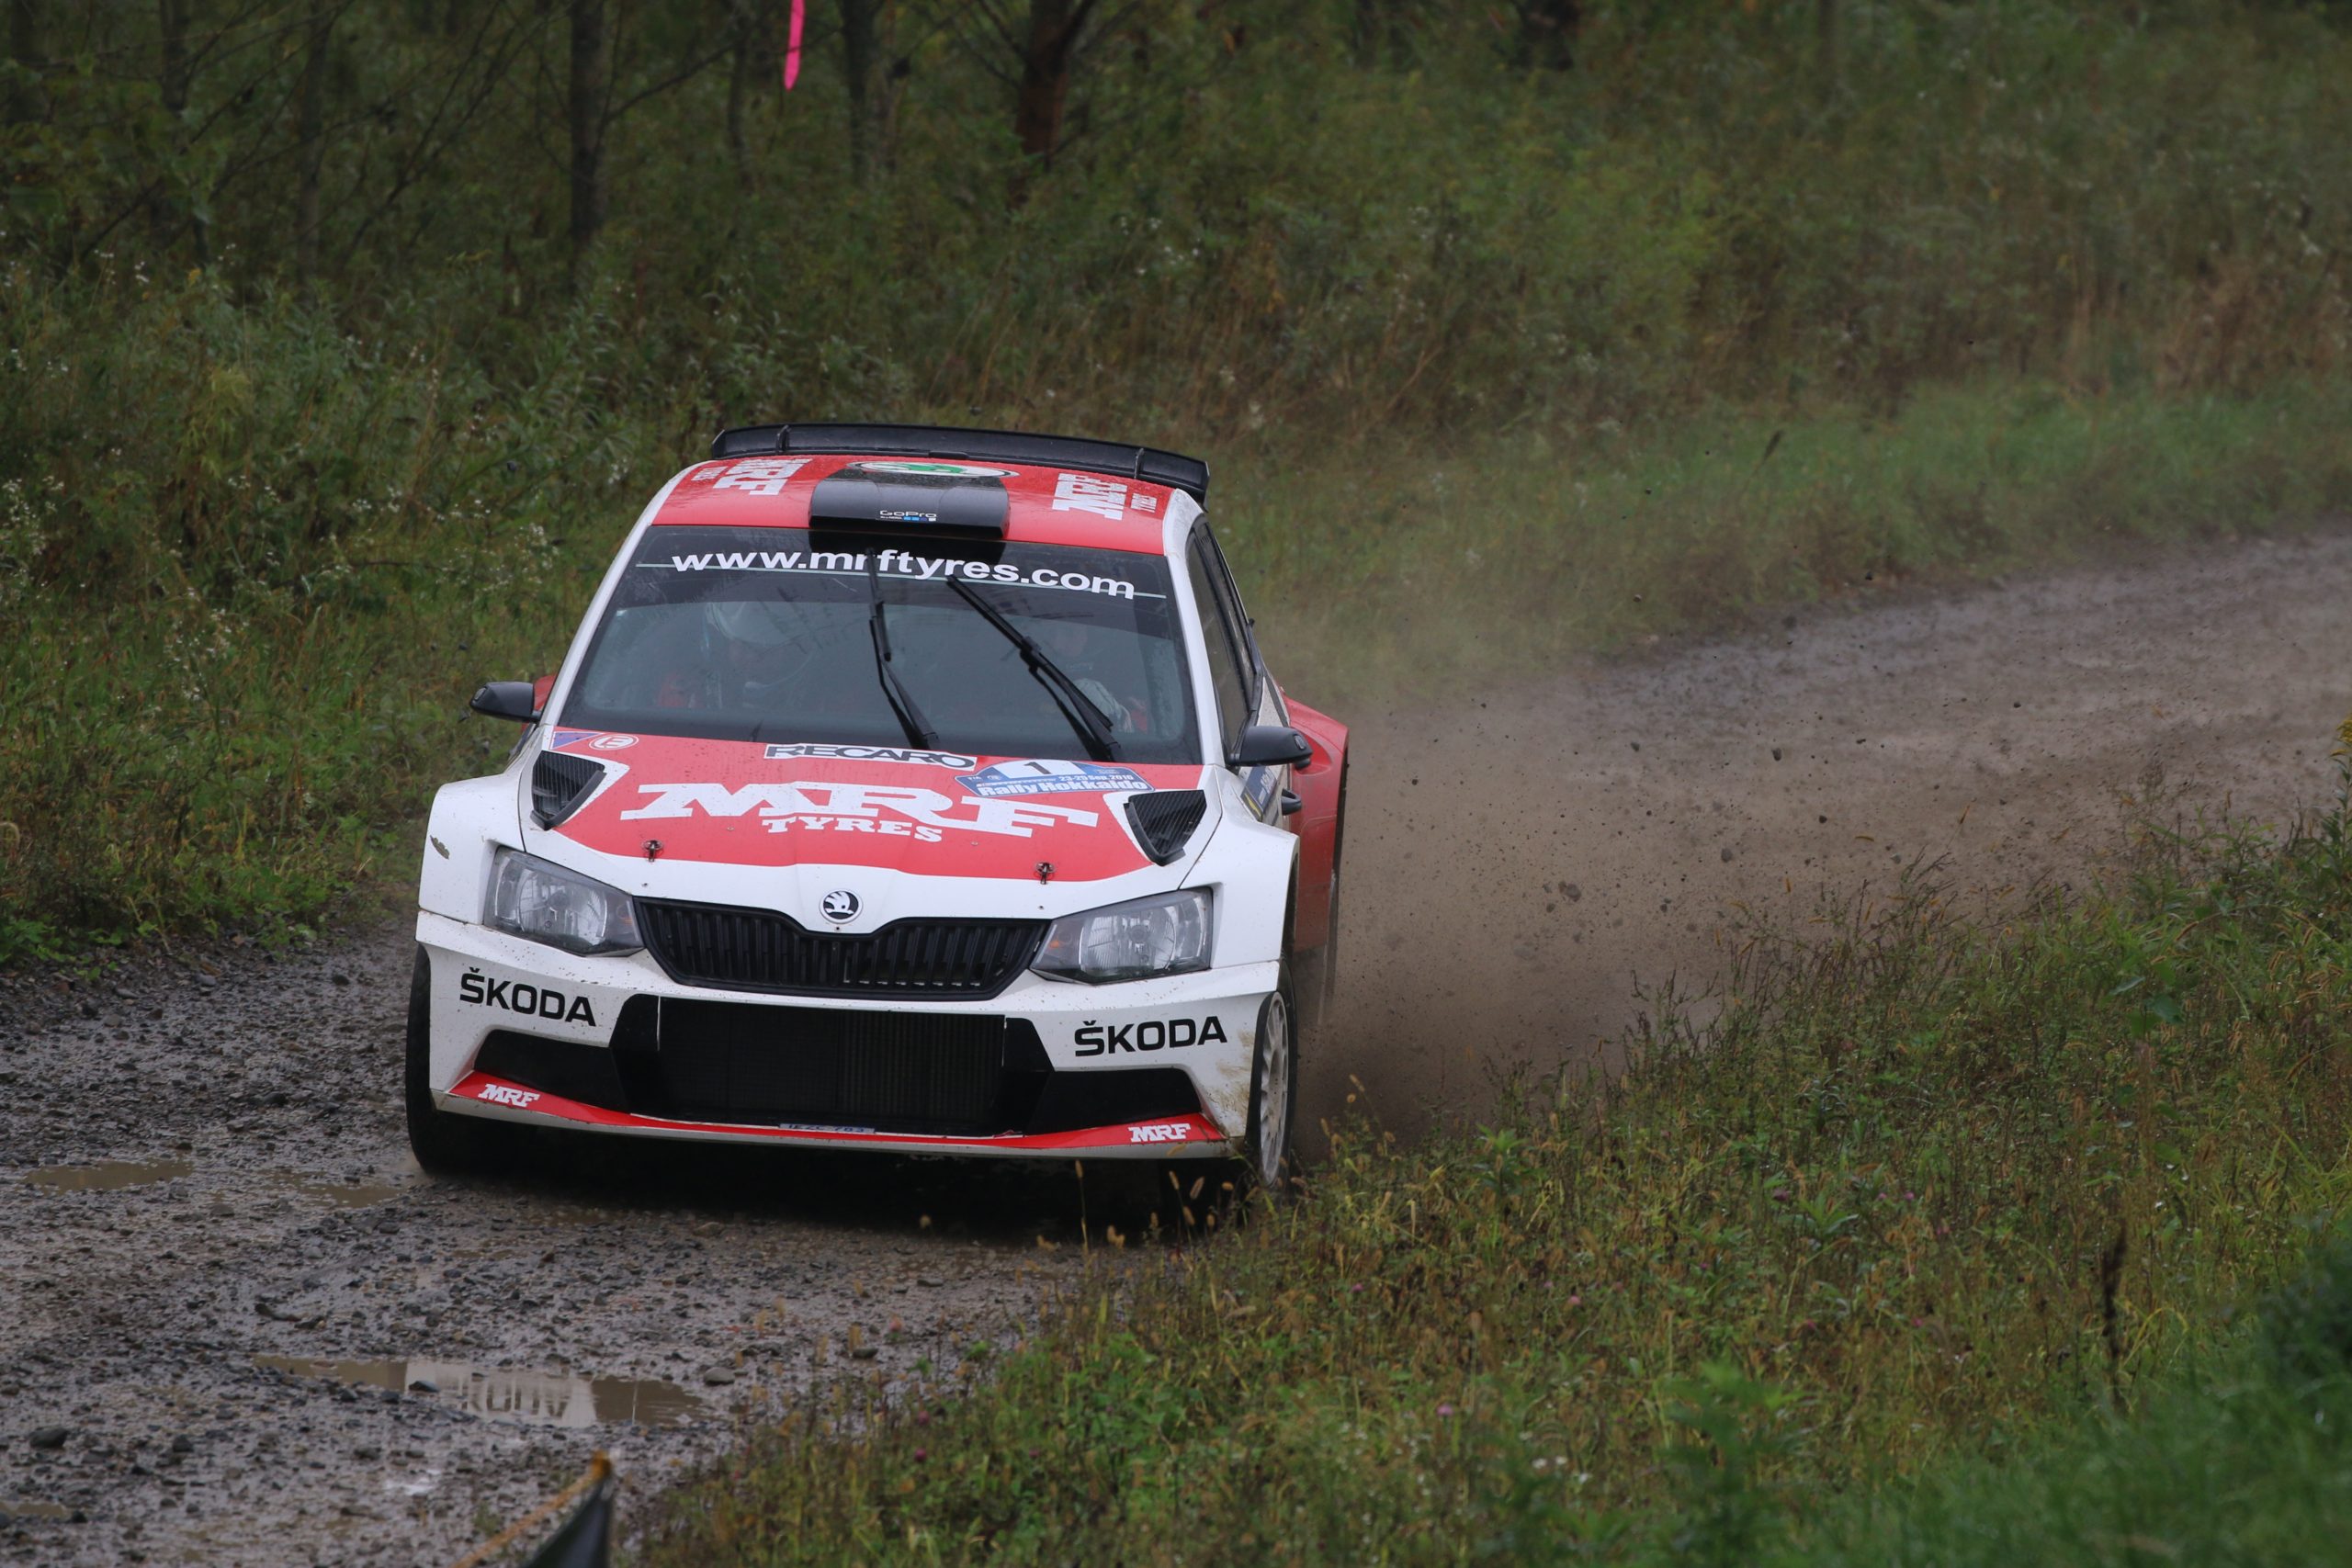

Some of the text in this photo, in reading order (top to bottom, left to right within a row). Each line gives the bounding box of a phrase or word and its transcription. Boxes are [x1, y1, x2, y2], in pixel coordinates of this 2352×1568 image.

[1052, 473, 1127, 520] MRF
[879, 510, 937, 518] GoPro
[672, 549, 1134, 600] www.mrftyres.com
[766, 745, 975, 768] RECARO
[1023, 761, 1052, 774] 1
[978, 784, 1038, 796] Rally
[1037, 780, 1148, 792] Hokkaido
[620, 781, 1099, 838] MRF
[762, 816, 943, 842] TYRES
[459, 967, 596, 1027] ŠKODA
[1074, 1016, 1227, 1057] ŠKODA
[478, 1084, 539, 1108] MRF
[1128, 1123, 1191, 1143] MRF
